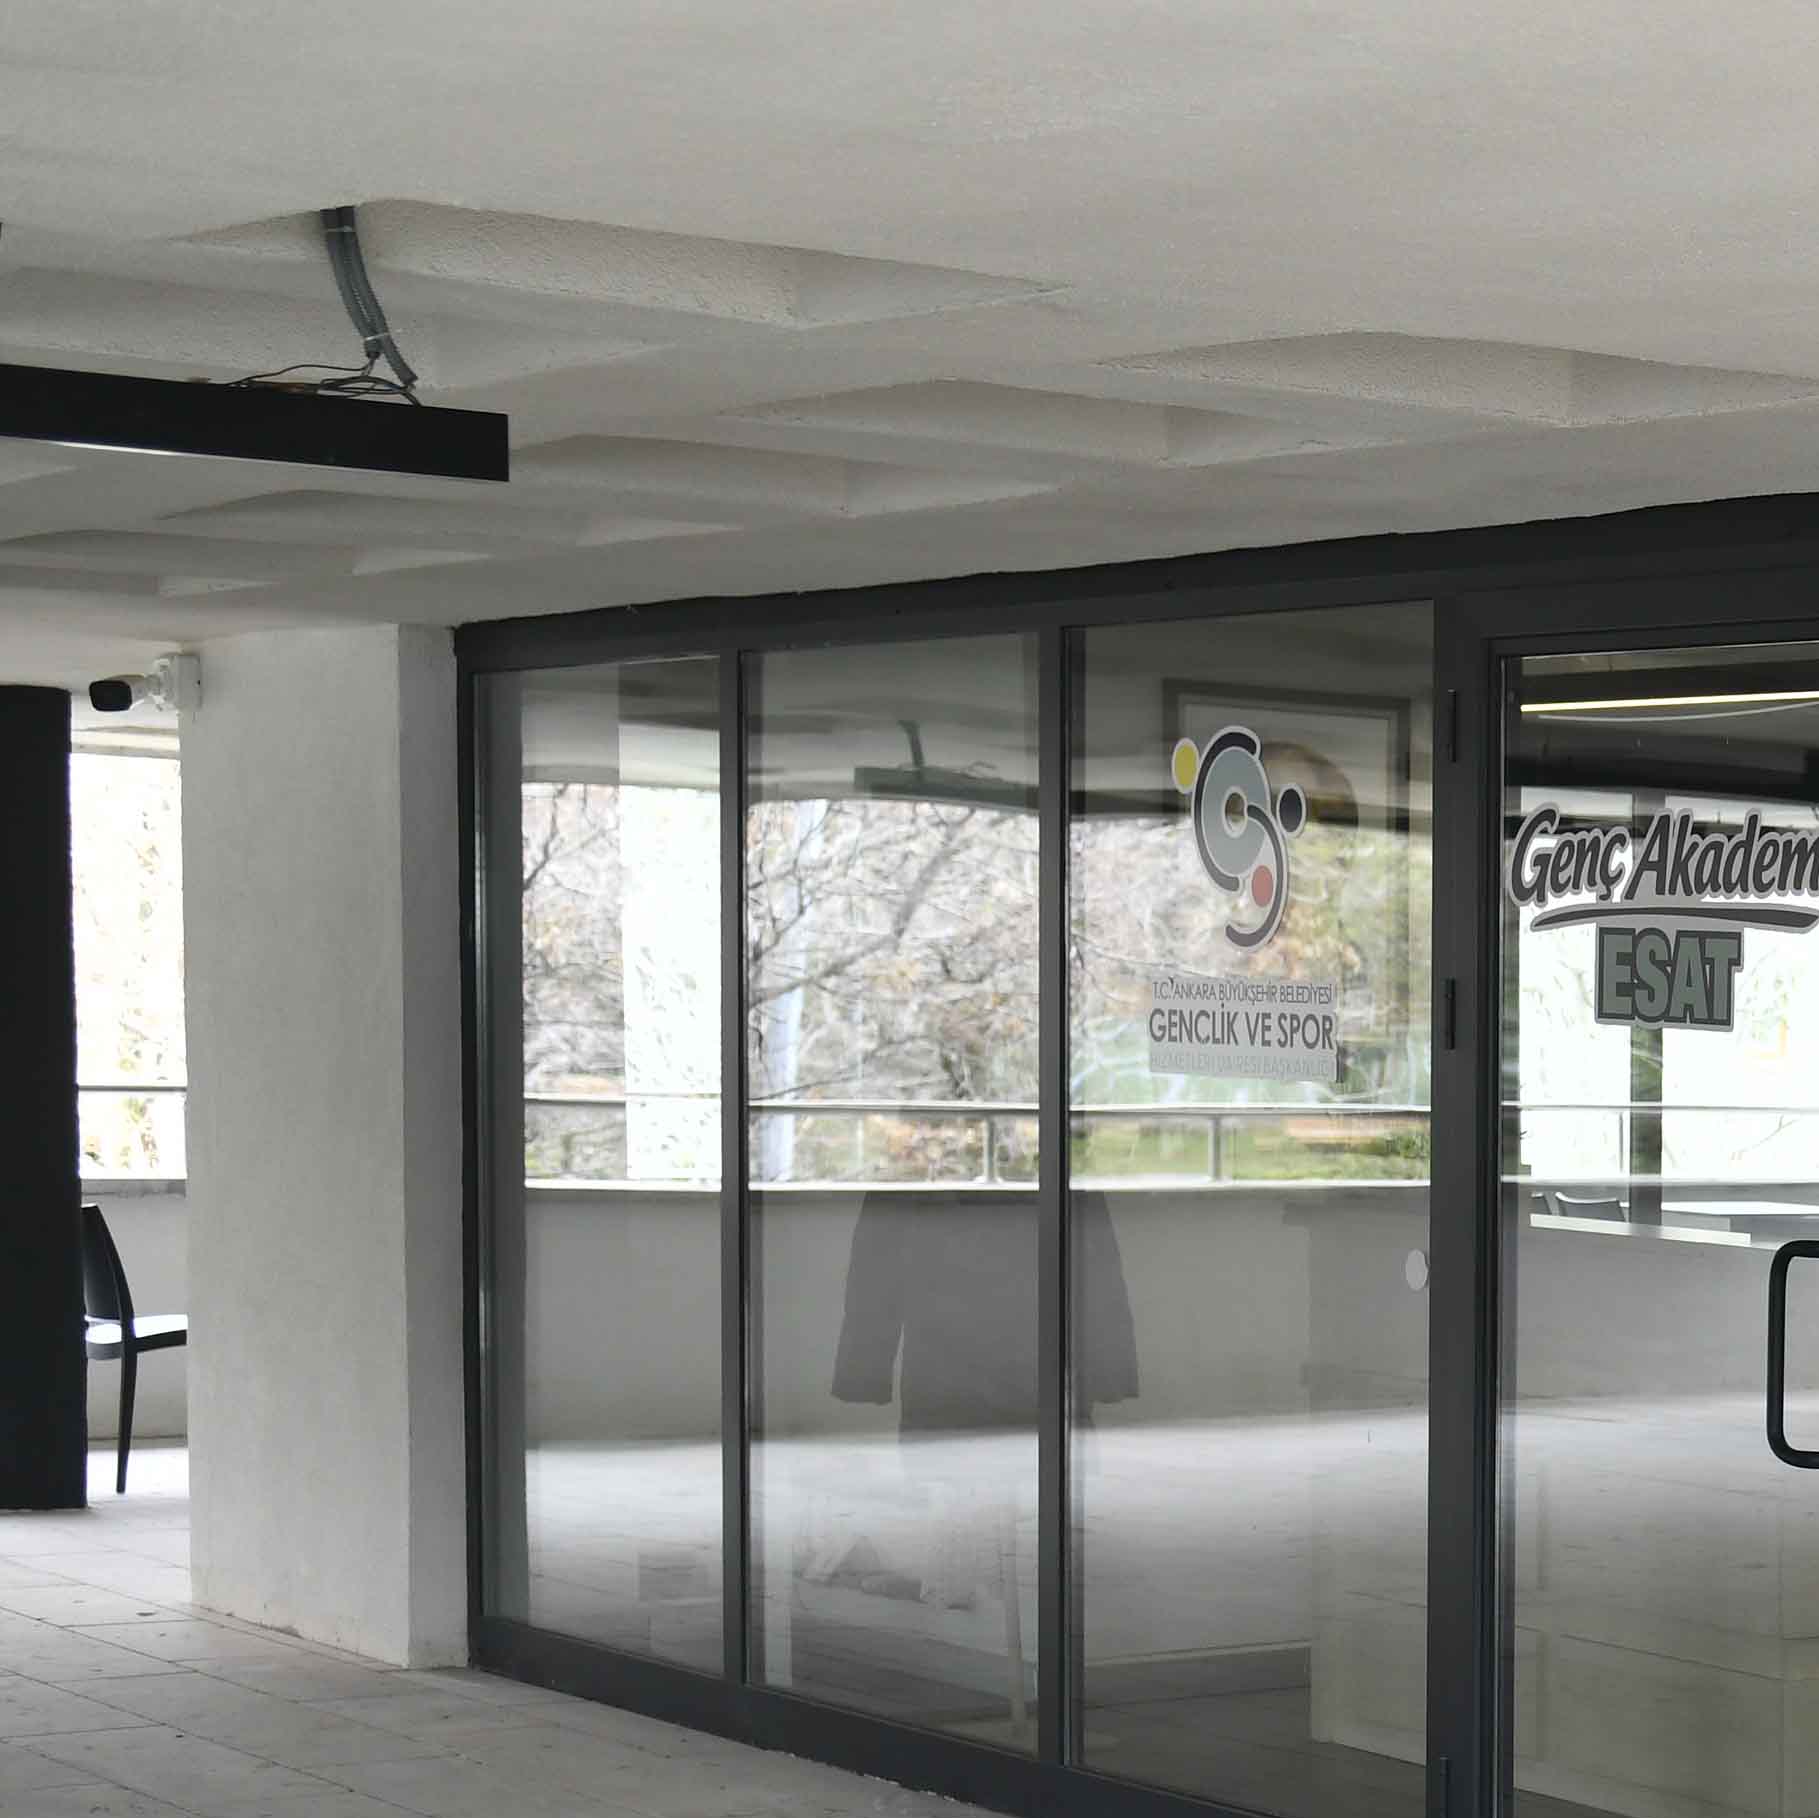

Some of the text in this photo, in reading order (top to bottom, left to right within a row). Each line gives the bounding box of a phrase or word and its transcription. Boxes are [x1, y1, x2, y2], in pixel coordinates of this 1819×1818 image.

[1511, 808, 1627, 901] Genç
[1599, 927, 1742, 1026] ESAT
[1245, 1011, 1272, 1047] VE
[1277, 1011, 1334, 1050] SPOR
